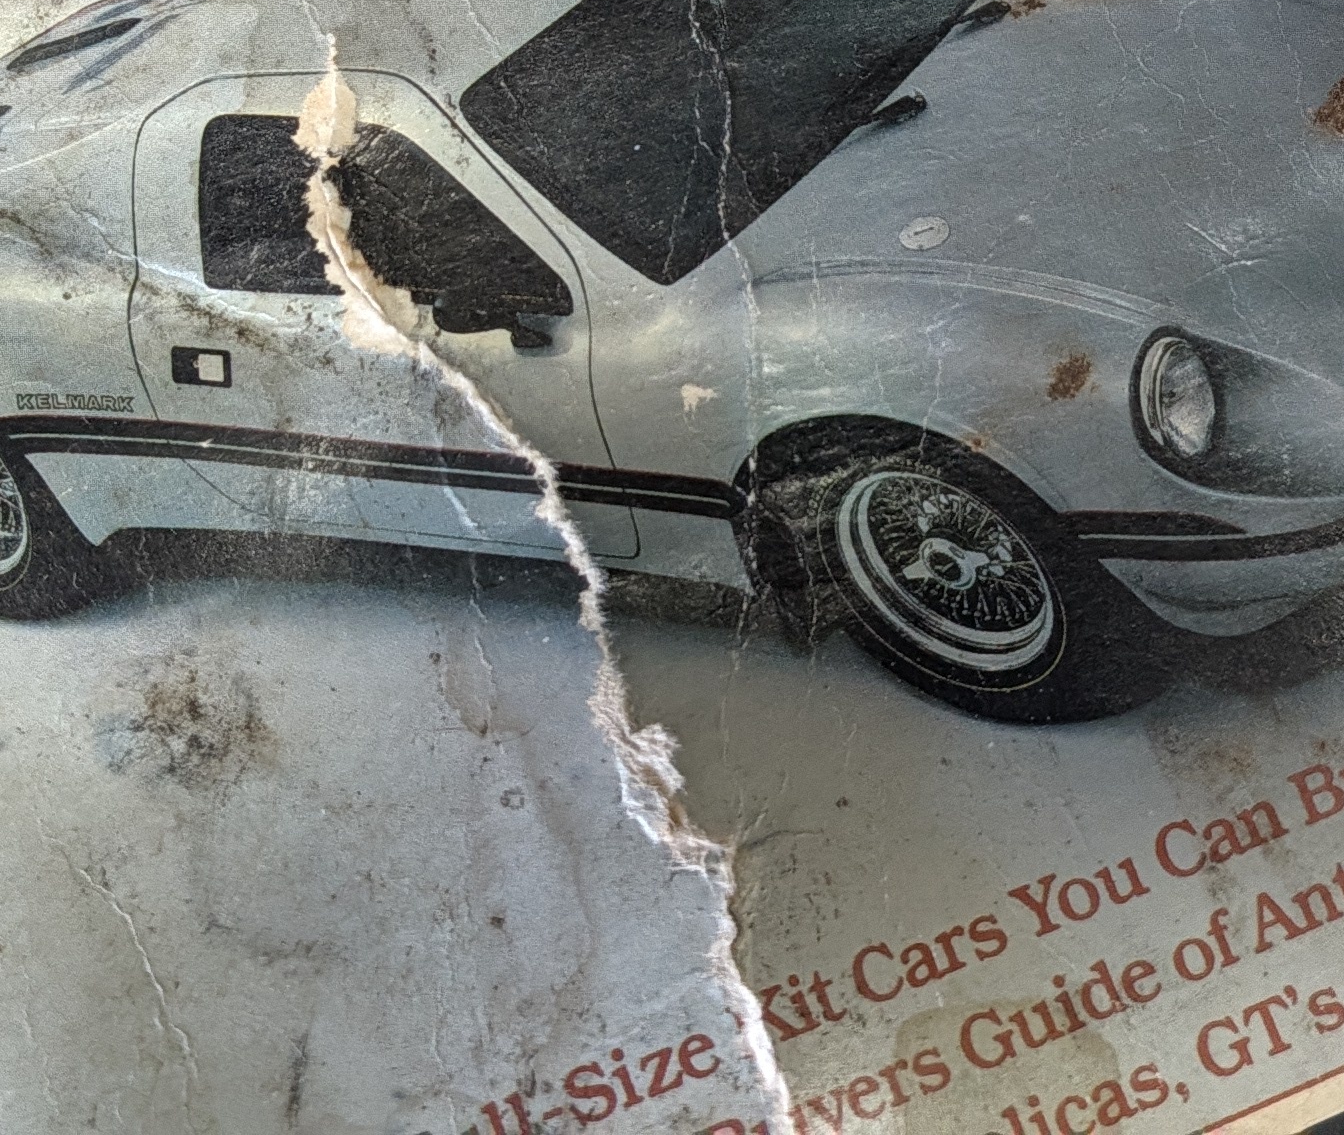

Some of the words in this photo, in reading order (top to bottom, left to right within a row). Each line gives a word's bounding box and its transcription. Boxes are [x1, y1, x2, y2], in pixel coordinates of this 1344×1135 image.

[16, 393, 135, 413] KELMARK
[462, 1033, 721, 1135] ll-Size
[738, 968, 848, 1043] Kit
[851, 912, 1008, 1003] Cars
[1008, 856, 1151, 939] You
[1155, 797, 1290, 878] Can
[959, 959, 1163, 1069] Guide
[1172, 915, 1241, 981] of
